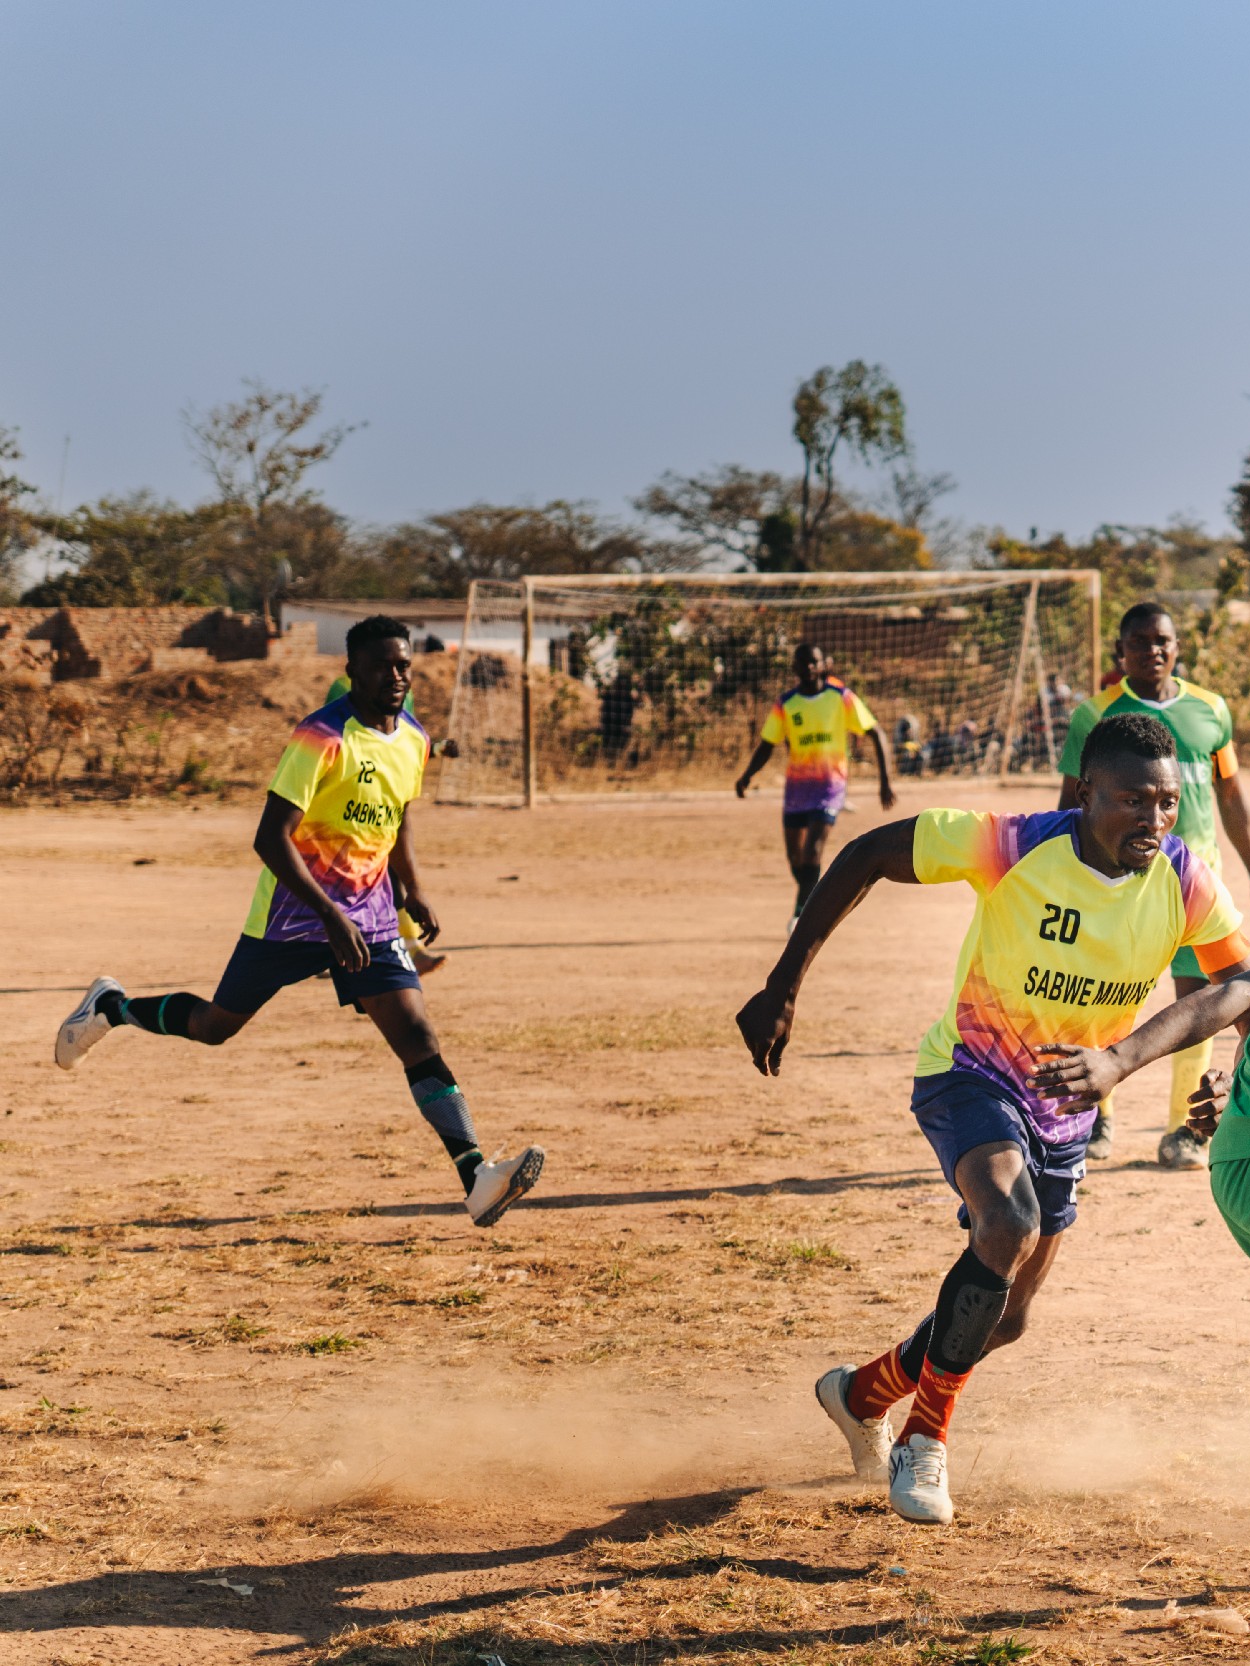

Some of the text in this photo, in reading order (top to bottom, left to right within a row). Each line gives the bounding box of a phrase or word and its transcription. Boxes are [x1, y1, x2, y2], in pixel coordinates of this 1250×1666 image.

[357, 760, 376, 783] 12
[343, 799, 384, 826] SABWE
[1039, 903, 1081, 945] 20
[1024, 966, 1095, 1006] SABWE
